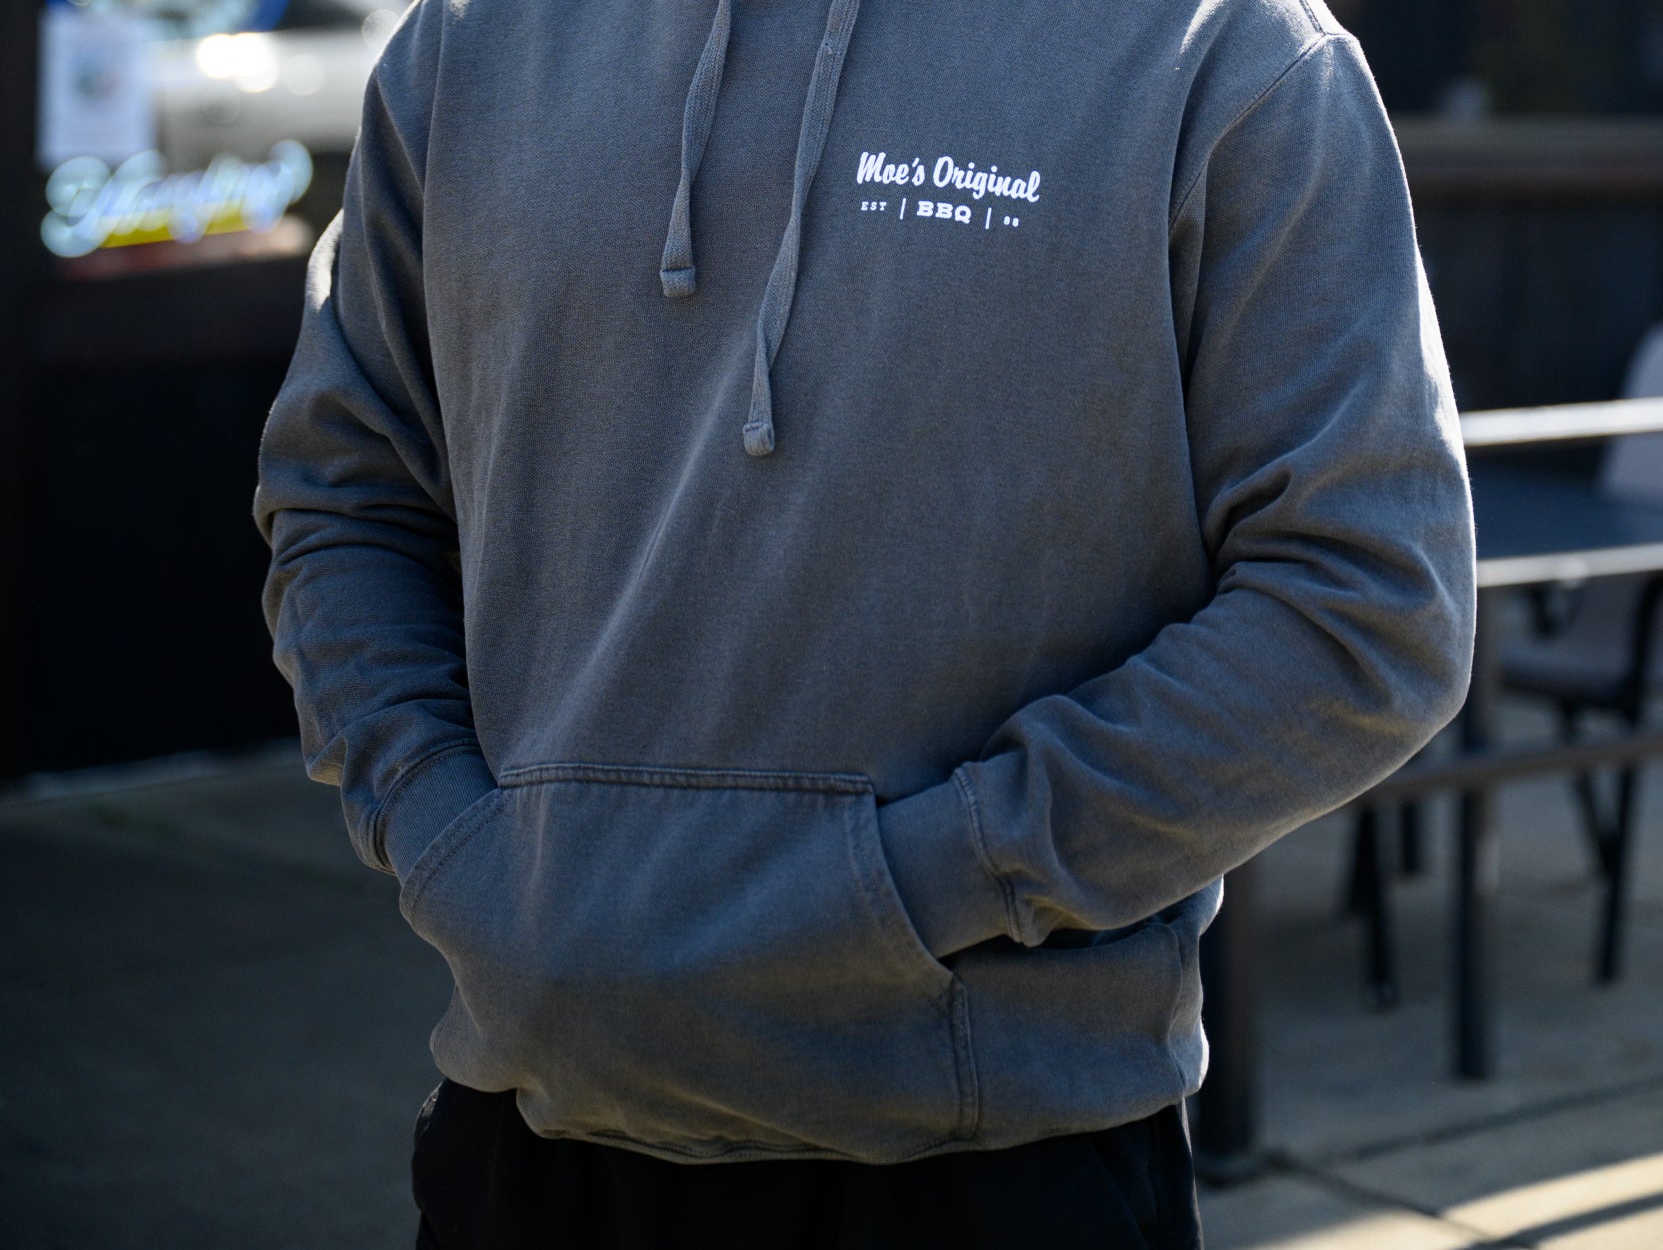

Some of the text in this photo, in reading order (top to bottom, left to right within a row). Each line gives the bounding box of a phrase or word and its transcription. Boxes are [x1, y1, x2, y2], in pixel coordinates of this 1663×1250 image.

[856, 151, 1041, 203] Moe's Original
[860, 201, 888, 212] EST
[916, 200, 972, 224] BBQ
